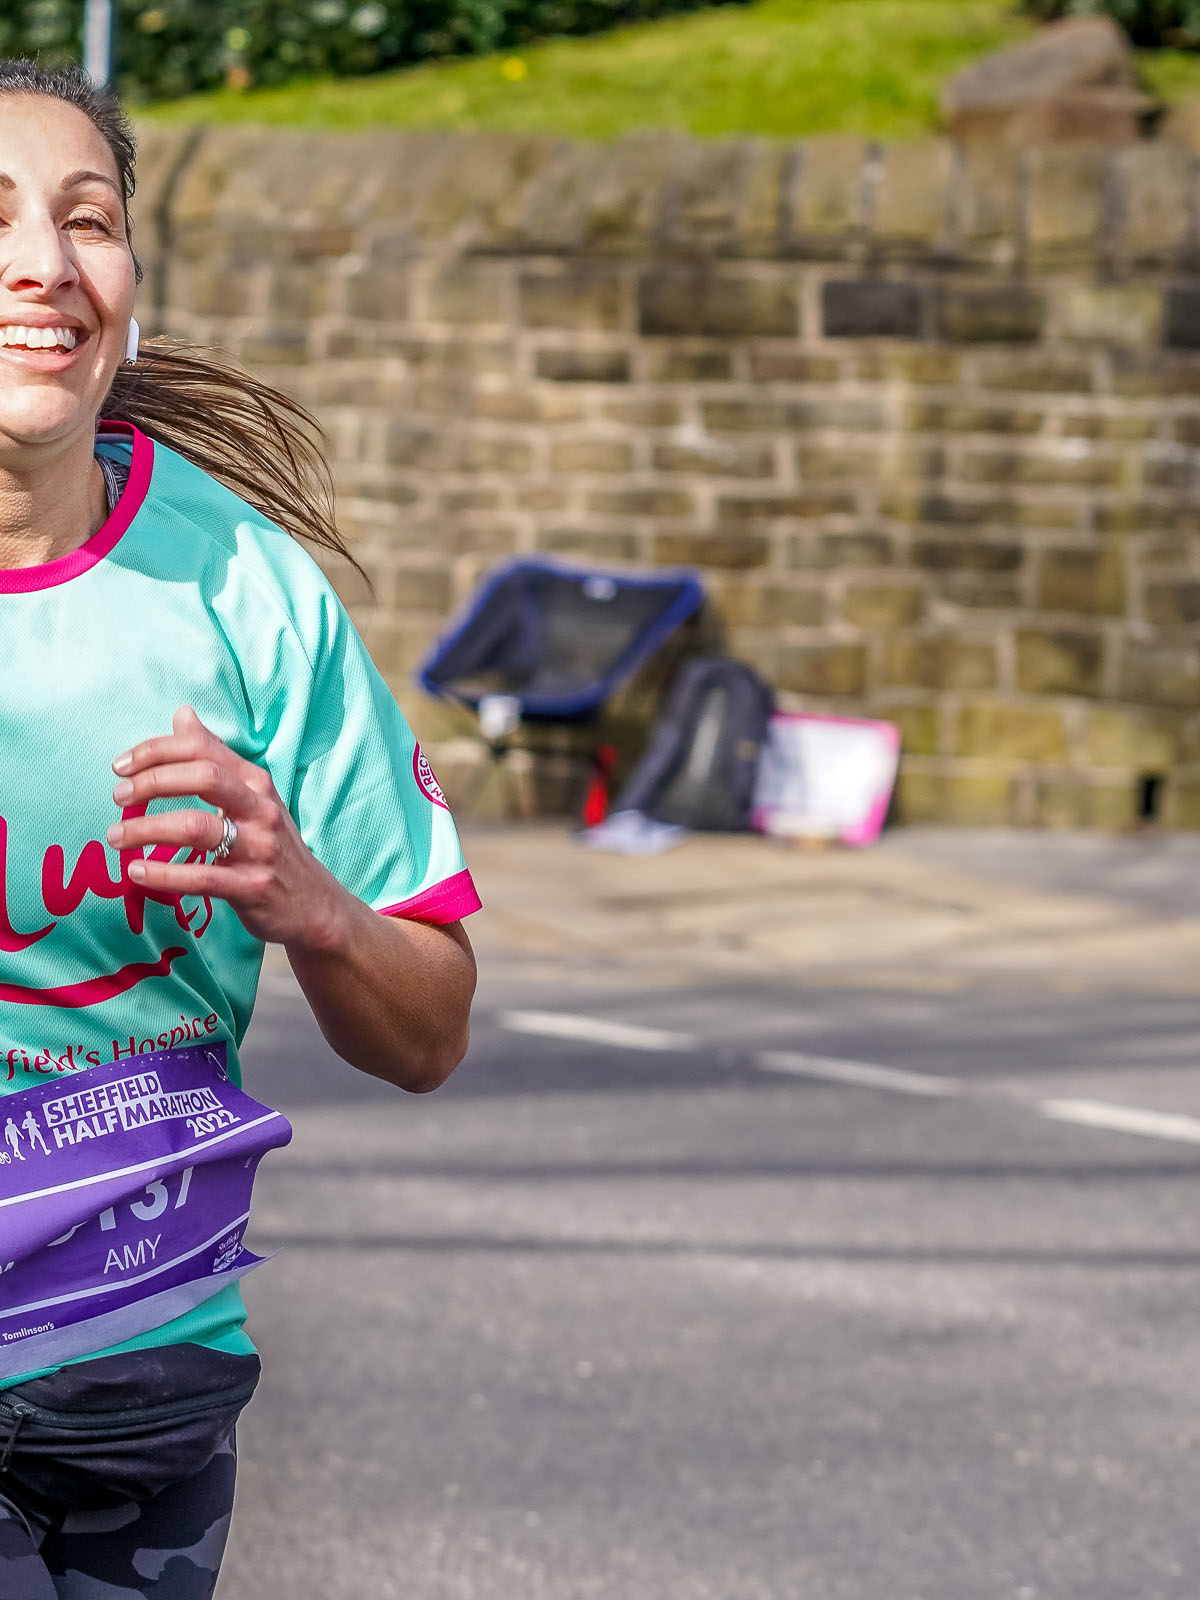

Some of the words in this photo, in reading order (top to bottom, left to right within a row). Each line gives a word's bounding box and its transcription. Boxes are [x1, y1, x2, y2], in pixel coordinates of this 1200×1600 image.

[111, 1013, 218, 1062] Hospice
[47, 1074, 160, 1124] SHEFFIELD
[53, 1111, 120, 1149] HALF
[124, 1089, 219, 1128] MARATHON
[186, 1109, 242, 1139] 2022
[103, 1233, 162, 1275] AMY
[1, 1321, 55, 1341] Tomlinson's
